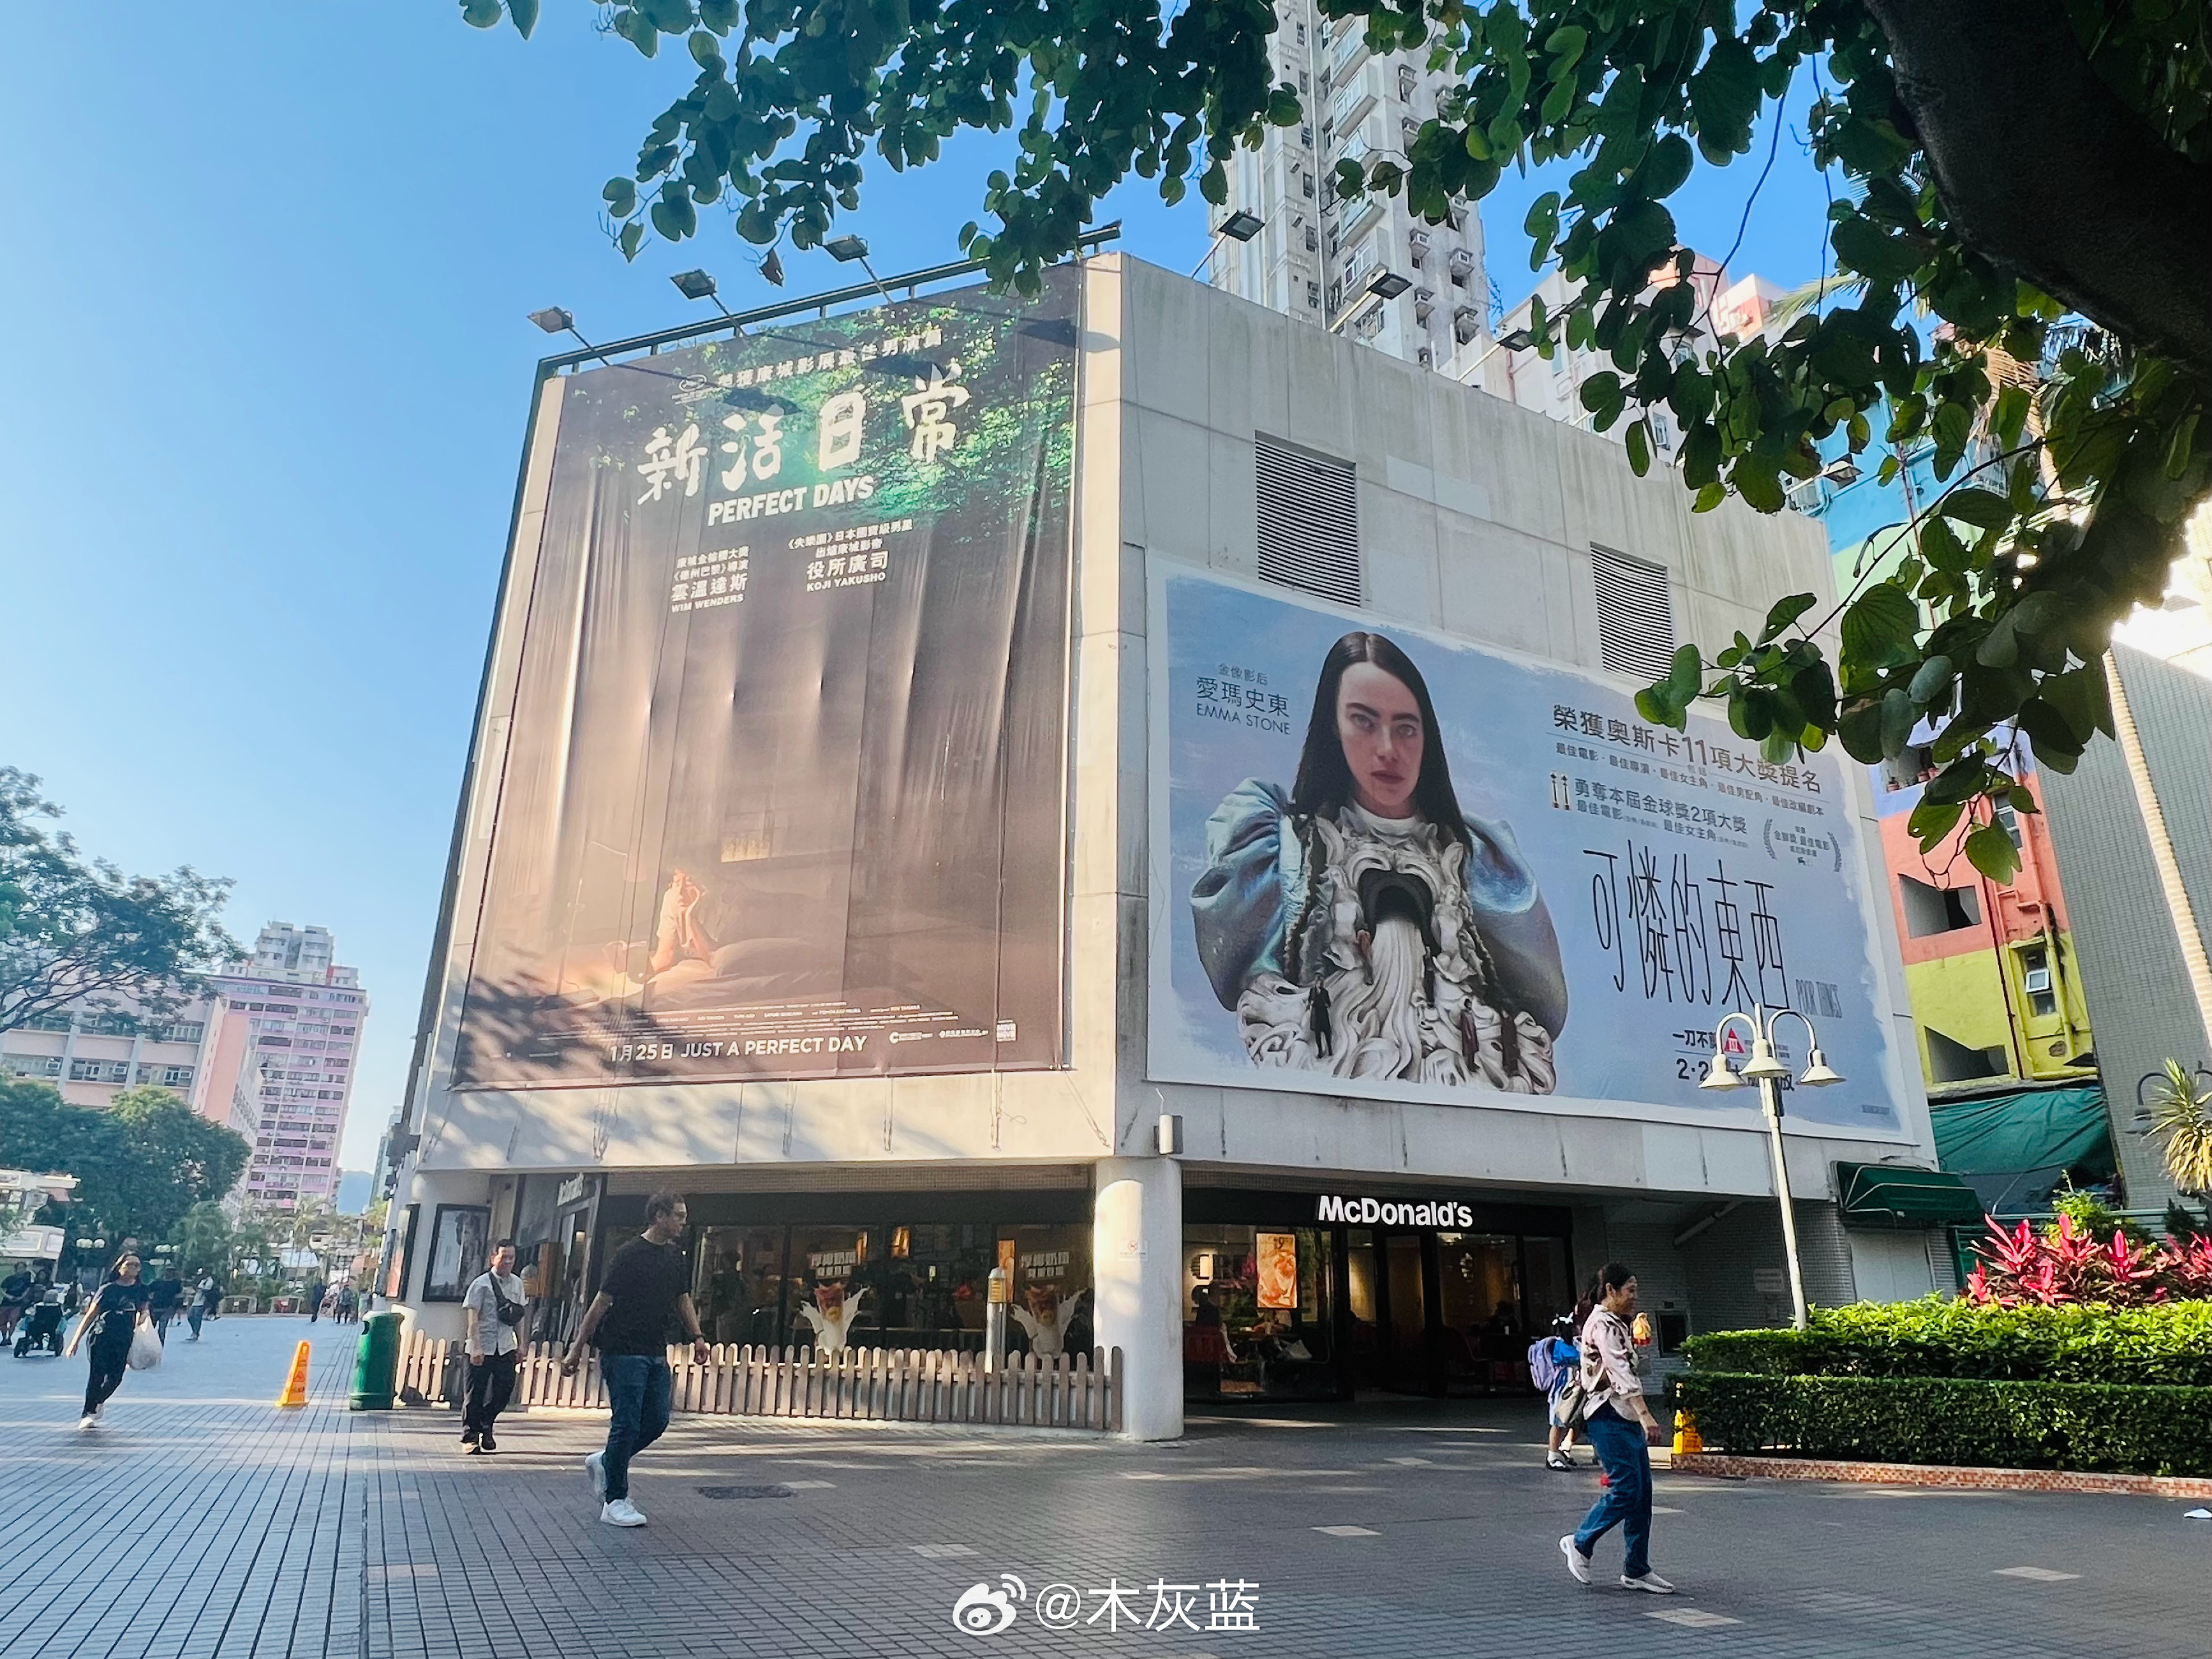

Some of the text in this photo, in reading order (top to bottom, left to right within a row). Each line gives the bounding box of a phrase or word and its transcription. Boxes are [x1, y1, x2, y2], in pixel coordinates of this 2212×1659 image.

[637, 362, 972, 505] 新活日常
[707, 476, 874, 526] PERFECT DAYS
[806, 551, 889, 581] 役所廣司
[806, 572, 886, 592] KOJI YAKUSHO
[671, 593, 745, 613] WIM WENDERS
[1217, 663, 1268, 686] 金像影后
[1196, 676, 1289, 718] 愛瑪史東
[1197, 703, 1291, 736] EMMA STONE
[1660, 768, 1708, 789] 最佳女主角
[1583, 840, 1790, 1012] 可憐的東西
[610, 1043, 674, 1063] 1月25日
[680, 1036, 867, 1059] JUST A PERFECT DAY
[1318, 1195, 1473, 1228] McDonald's
